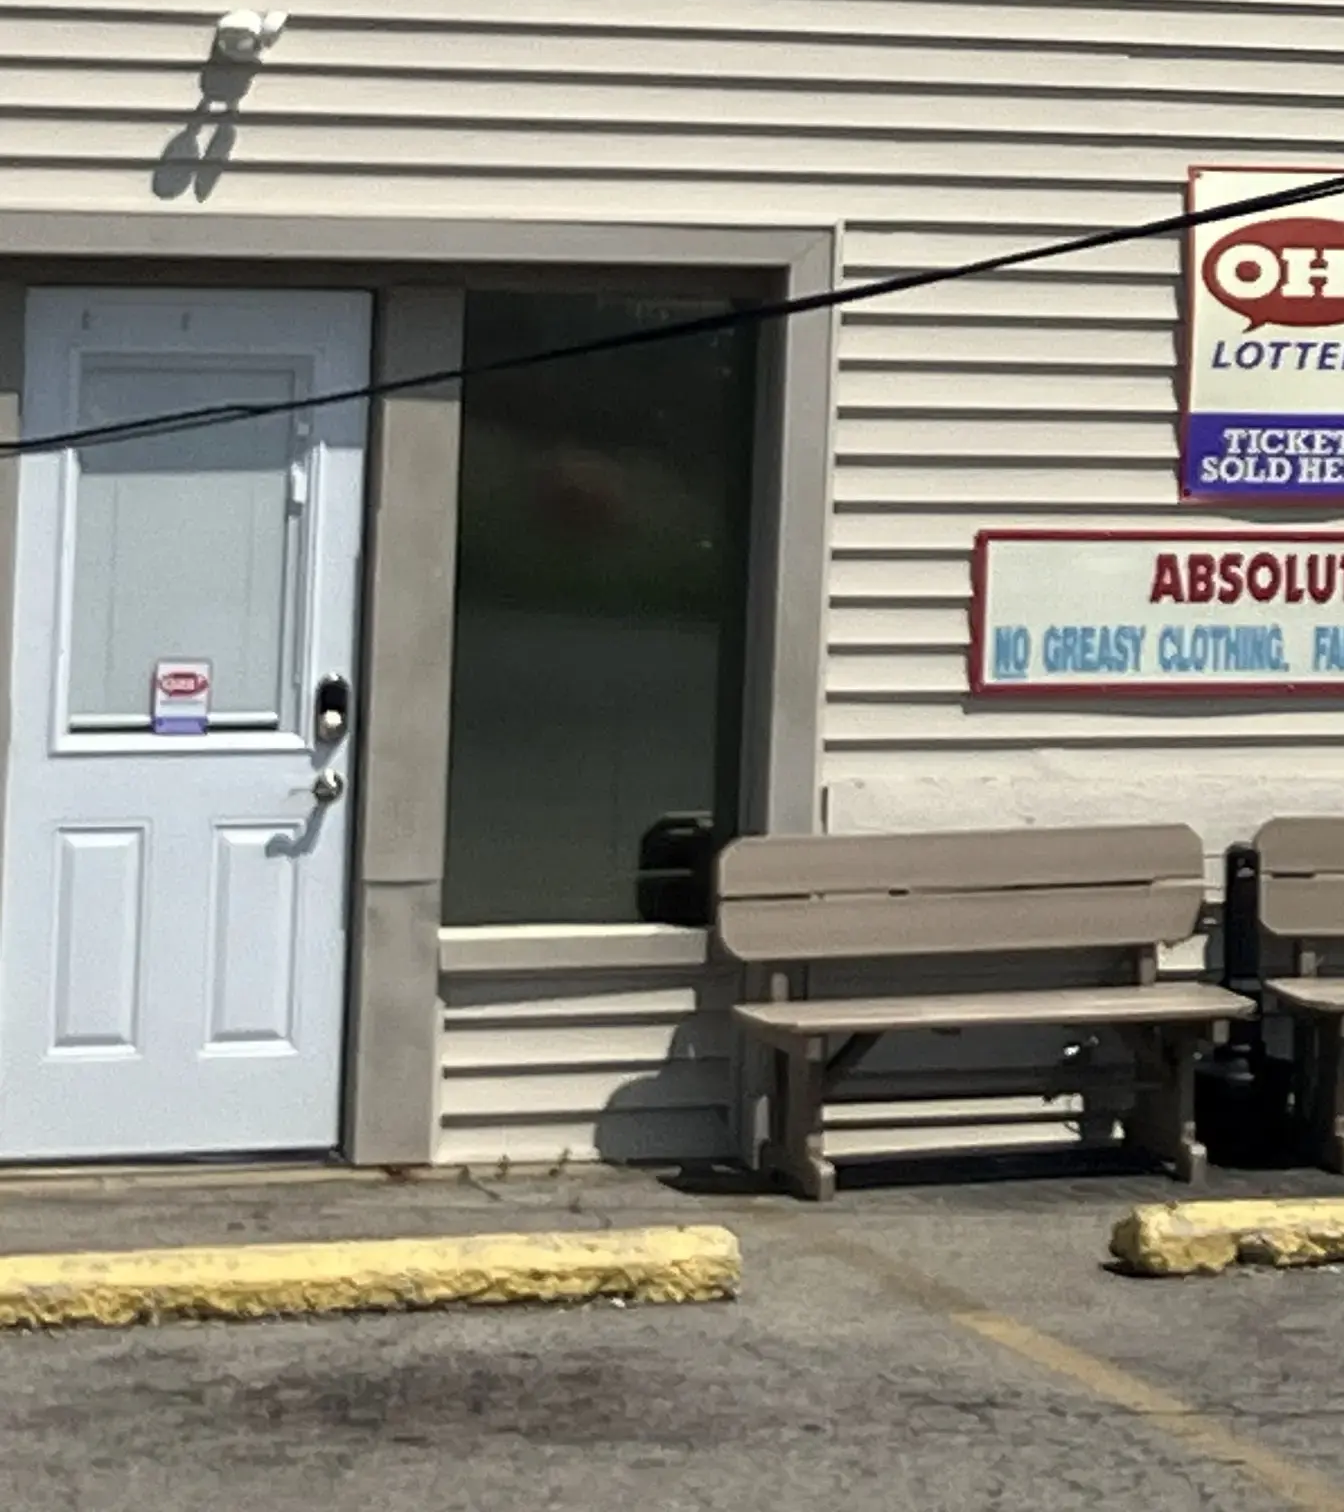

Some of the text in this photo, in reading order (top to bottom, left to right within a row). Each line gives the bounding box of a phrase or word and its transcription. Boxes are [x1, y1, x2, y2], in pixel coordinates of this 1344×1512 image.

[1200, 456, 1292, 484] SOLD
[993, 625, 1029, 672] NO
[1042, 625, 1147, 673] GREASY
